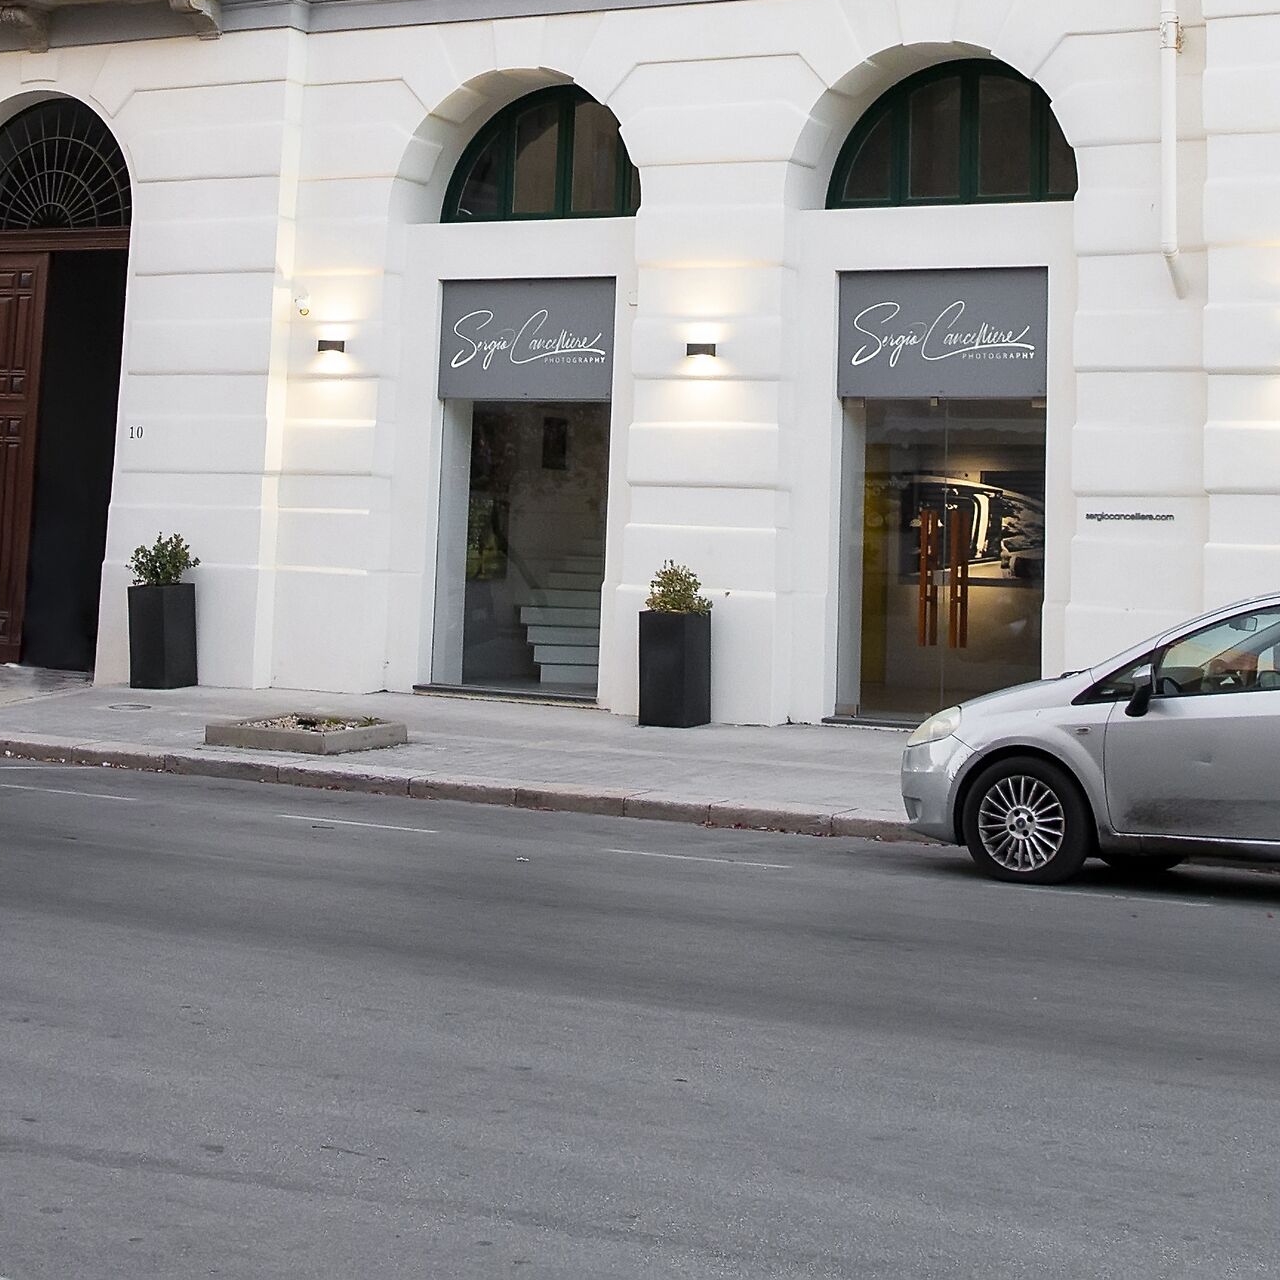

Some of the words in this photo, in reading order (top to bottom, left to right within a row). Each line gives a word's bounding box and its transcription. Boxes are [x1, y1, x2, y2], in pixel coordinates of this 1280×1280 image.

[451, 310, 515, 370] Sergio
[510, 309, 606, 364] Cancelliere
[851, 301, 925, 367] Sergio
[921, 301, 1035, 360] Cancelliere
[544, 356, 606, 364] PHOTOGRAPHY
[961, 351, 1035, 360] PHOTOGRAPHY
[129, 425, 144, 439] 10
